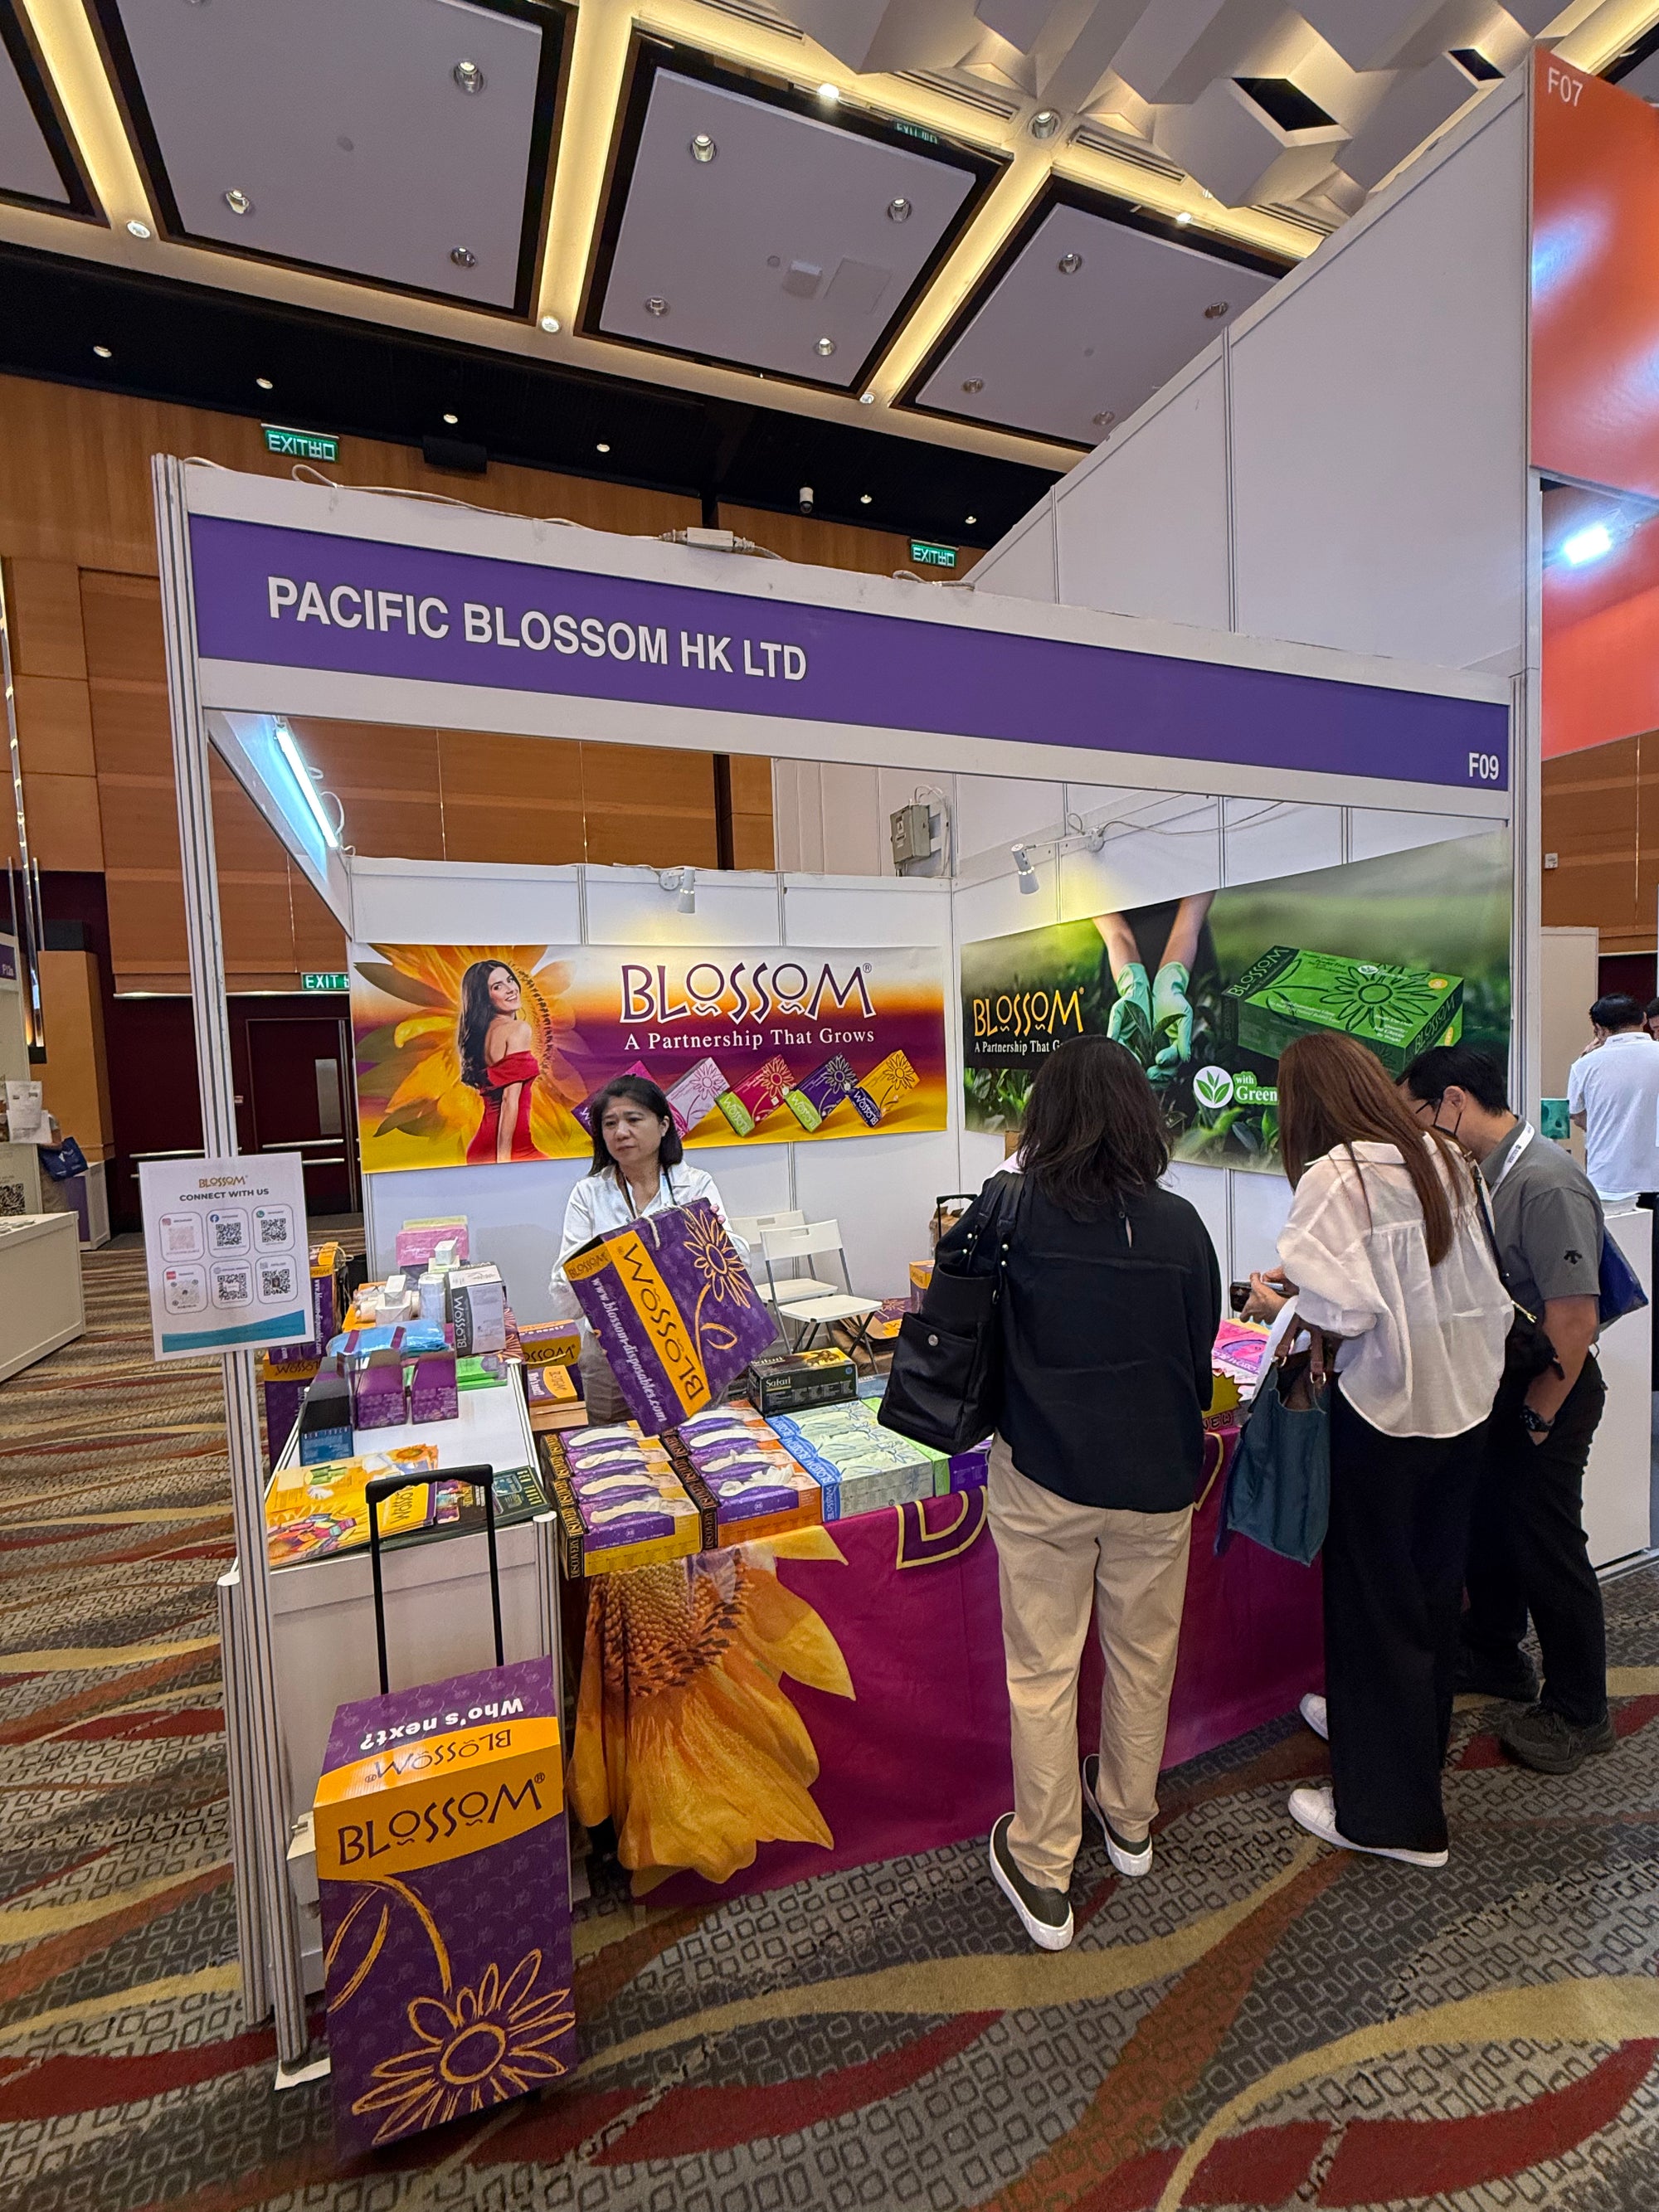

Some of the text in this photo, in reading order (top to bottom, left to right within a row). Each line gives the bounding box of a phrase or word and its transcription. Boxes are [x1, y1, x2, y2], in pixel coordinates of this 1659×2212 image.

[1548, 66, 1584, 107] F07
[268, 433, 308, 456] EXIT
[913, 547, 937, 564] EXIT
[267, 576, 808, 681] PACIFIC BLOSSOM HK LTD
[1468, 751, 1499, 780] F09
[305, 975, 339, 989] EXIT
[625, 1028, 875, 1050] A Partnership That Grows
[975, 1042, 980, 1053] A
[982, 1040, 1028, 1056] Partnership
[1029, 1039, 1050, 1053] That
[1235, 1075, 1254, 1084] with
[1236, 1086, 1277, 1101] Green
[853, 1090, 879, 1126] BLOSSOM
[199, 1175, 246, 1189] BLOSSOM
[179, 1192, 226, 1202] CONNECT
[229, 1189, 254, 1198] WITH
[568, 1253, 609, 1278] BLOSSOM
[453, 1296, 467, 1349] BLOSSOM
[591, 1277, 668, 1423] www.blossom-disposables.com
[766, 1376, 791, 1388] Safari
[359, 1698, 524, 1751] Who's next?
